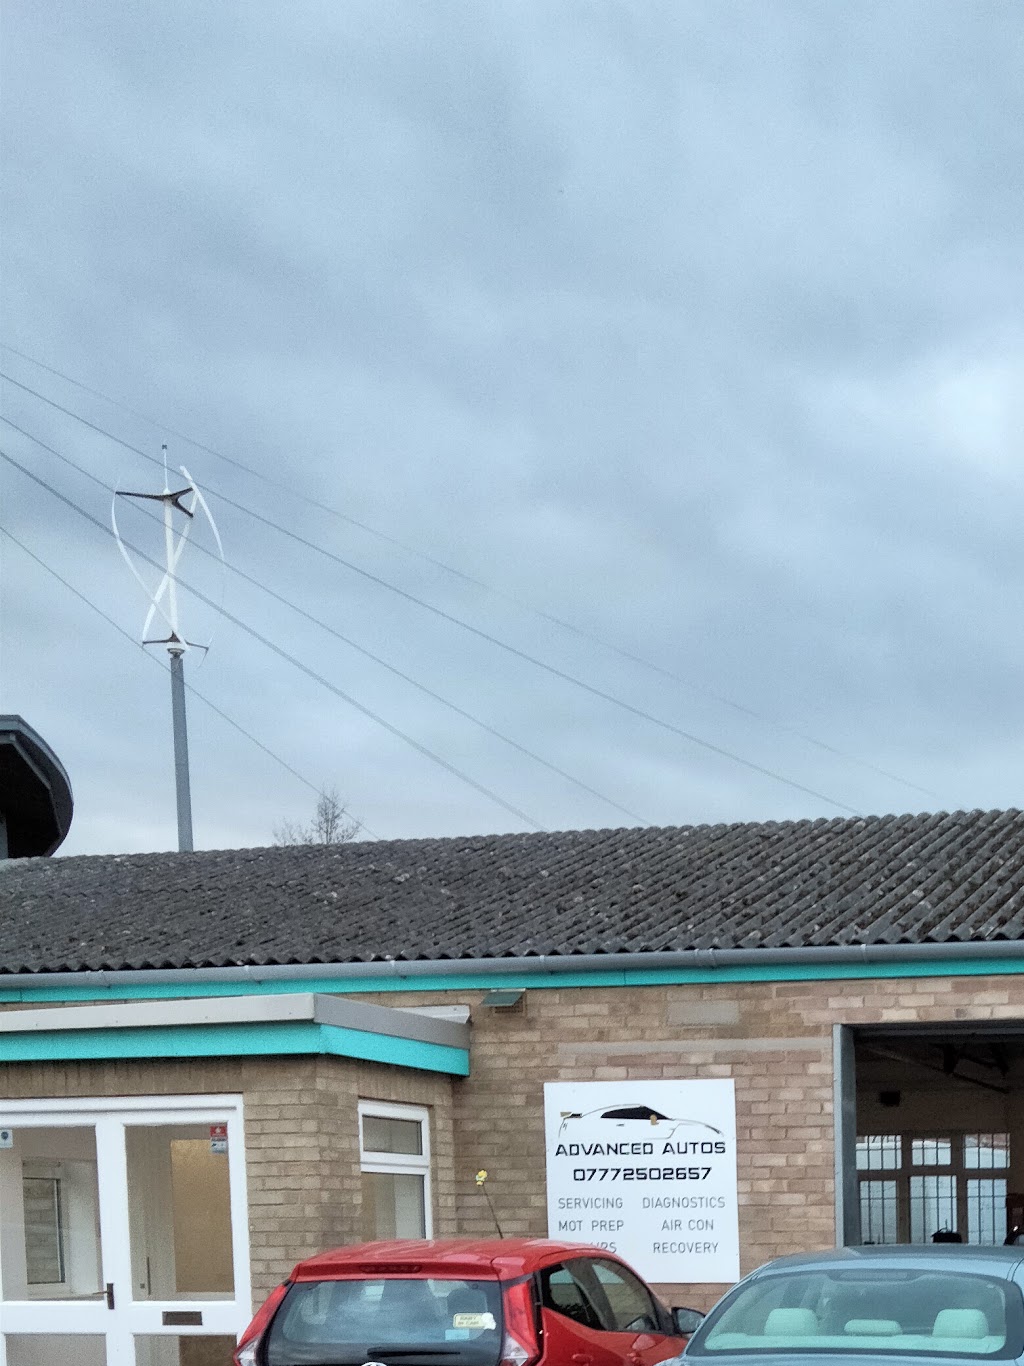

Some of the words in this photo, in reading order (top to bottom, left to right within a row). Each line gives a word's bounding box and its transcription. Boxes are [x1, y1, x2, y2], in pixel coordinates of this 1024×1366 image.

[555, 1142, 654, 1156] ADVANCED
[662, 1141, 726, 1155] AUTOS
[573, 1167, 712, 1181] 07772502657
[558, 1198, 624, 1209] SERVICING
[642, 1197, 726, 1208] DIAGNOSTICS
[558, 1220, 583, 1231] MOT
[591, 1220, 624, 1231] PREP
[661, 1219, 682, 1231] AIR
[688, 1219, 714, 1231] CON
[653, 1242, 719, 1254] RECOVERY
